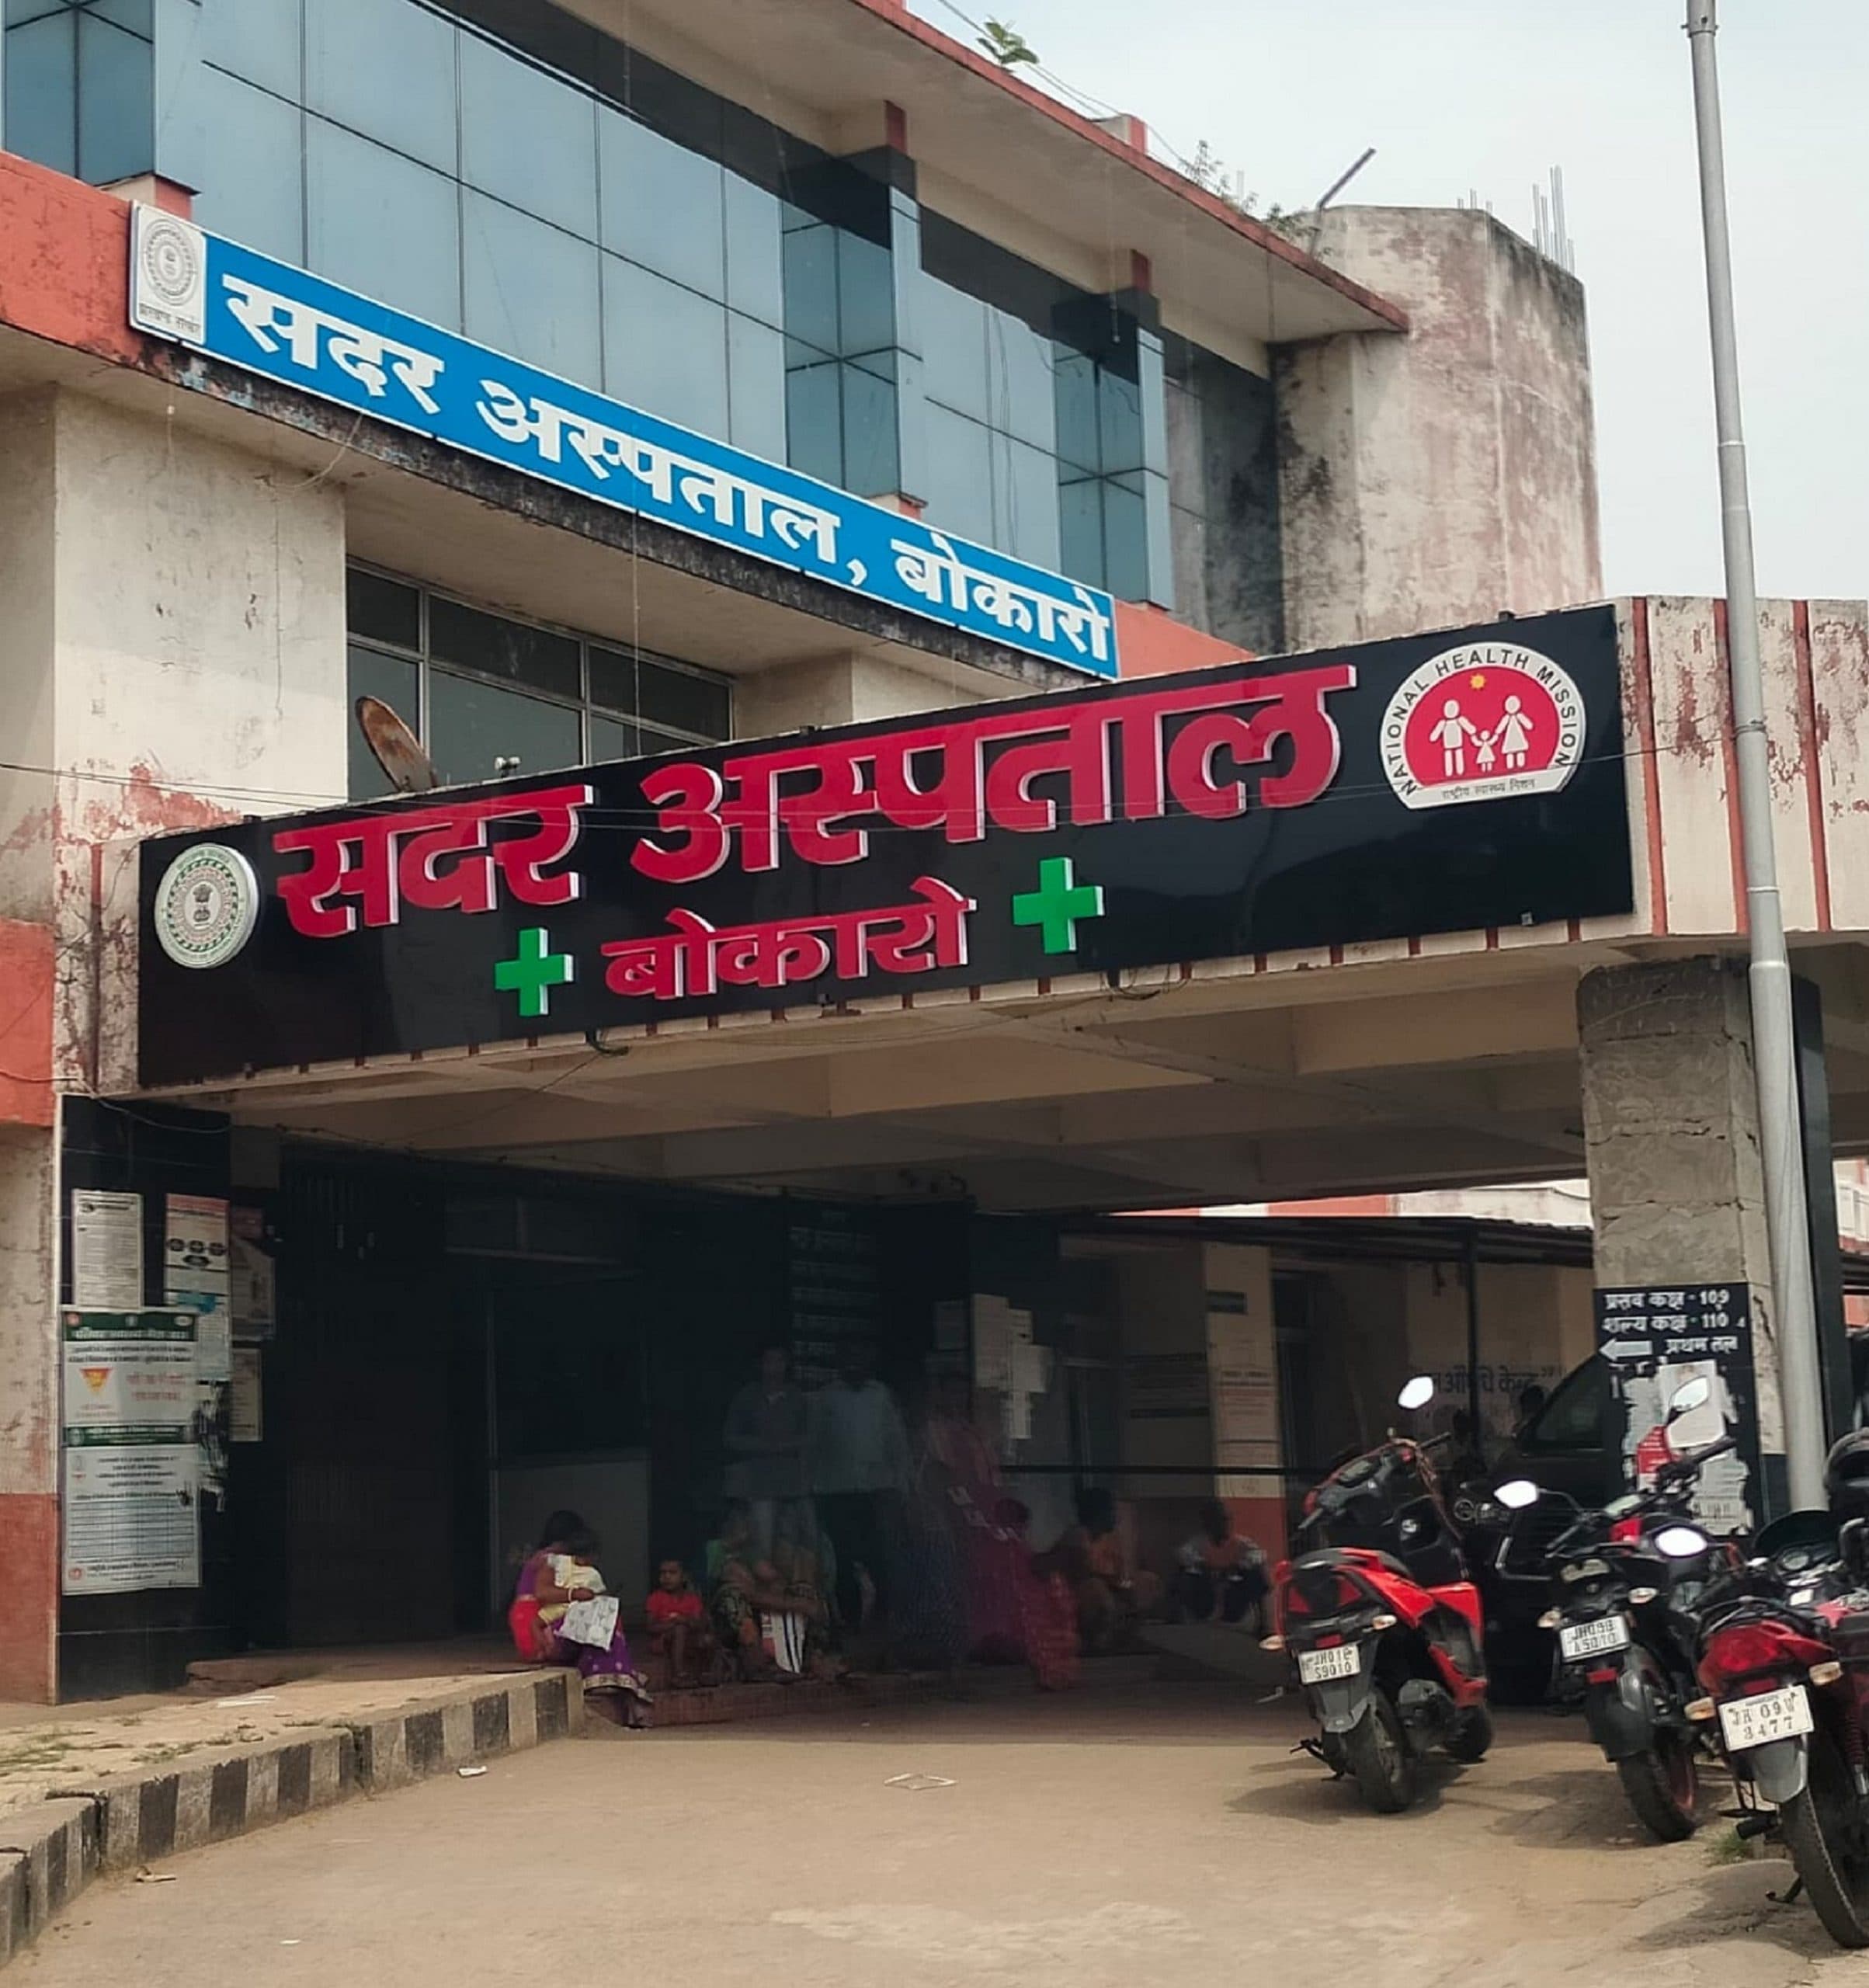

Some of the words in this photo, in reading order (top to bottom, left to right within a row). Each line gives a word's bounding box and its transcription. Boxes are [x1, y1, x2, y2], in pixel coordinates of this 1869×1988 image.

[221, 273, 446, 415] सदर
[890, 531, 1111, 662] बोकारो
[1387, 679, 1430, 797] NATIONAL
[1435, 648, 1530, 677] HEALTH
[1536, 665, 1578, 768] MISSION
[273, 784, 594, 938] सदर
[630, 664, 1357, 883] अस्पताल
[600, 875, 977, 1000] बोकारो
[1701, 1312, 1728, 1328] 110
[1710, 1336, 1739, 1354] तल
